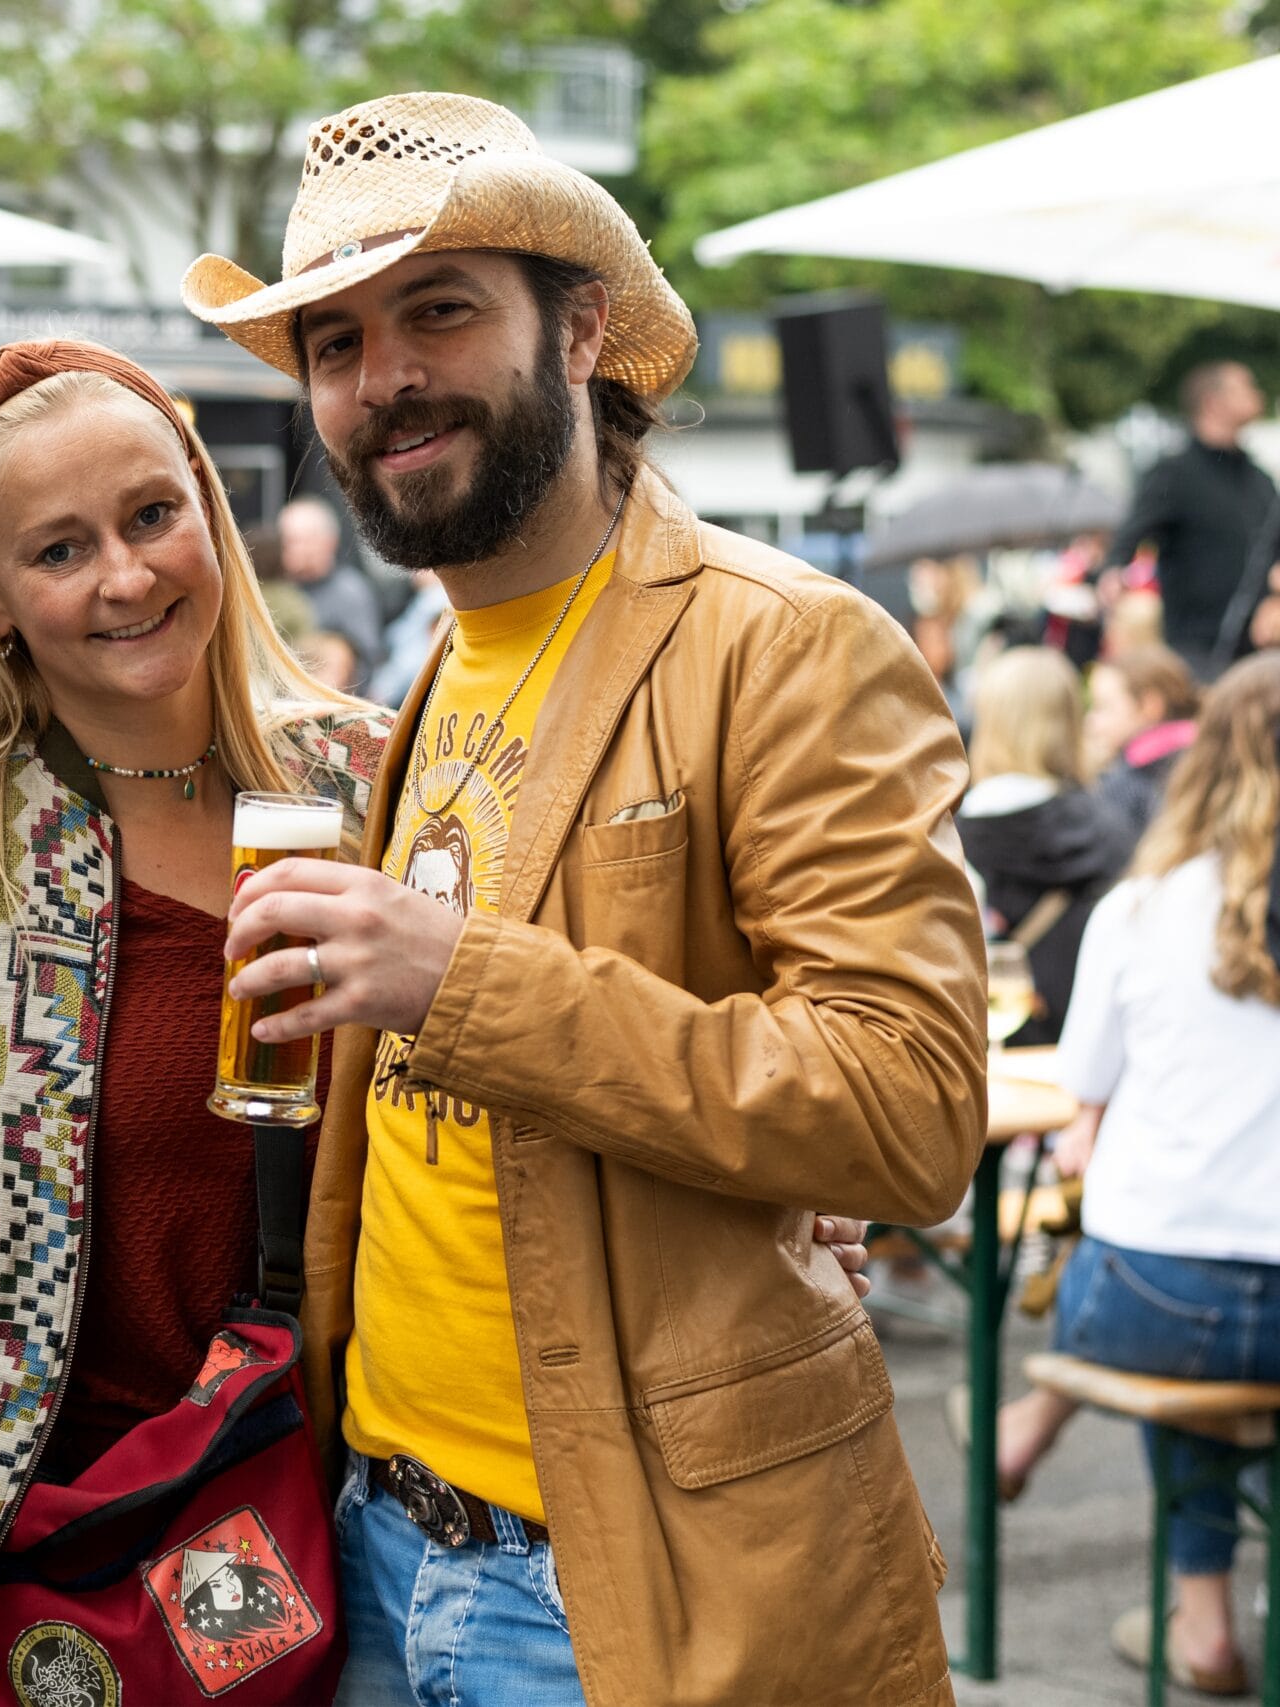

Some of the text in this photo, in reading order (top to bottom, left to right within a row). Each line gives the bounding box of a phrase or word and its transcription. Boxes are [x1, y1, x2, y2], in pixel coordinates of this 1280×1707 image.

[435, 712, 459, 761] IS
[41, 1628, 63, 1637] NOI
[95, 1655, 116, 1699] NANG
